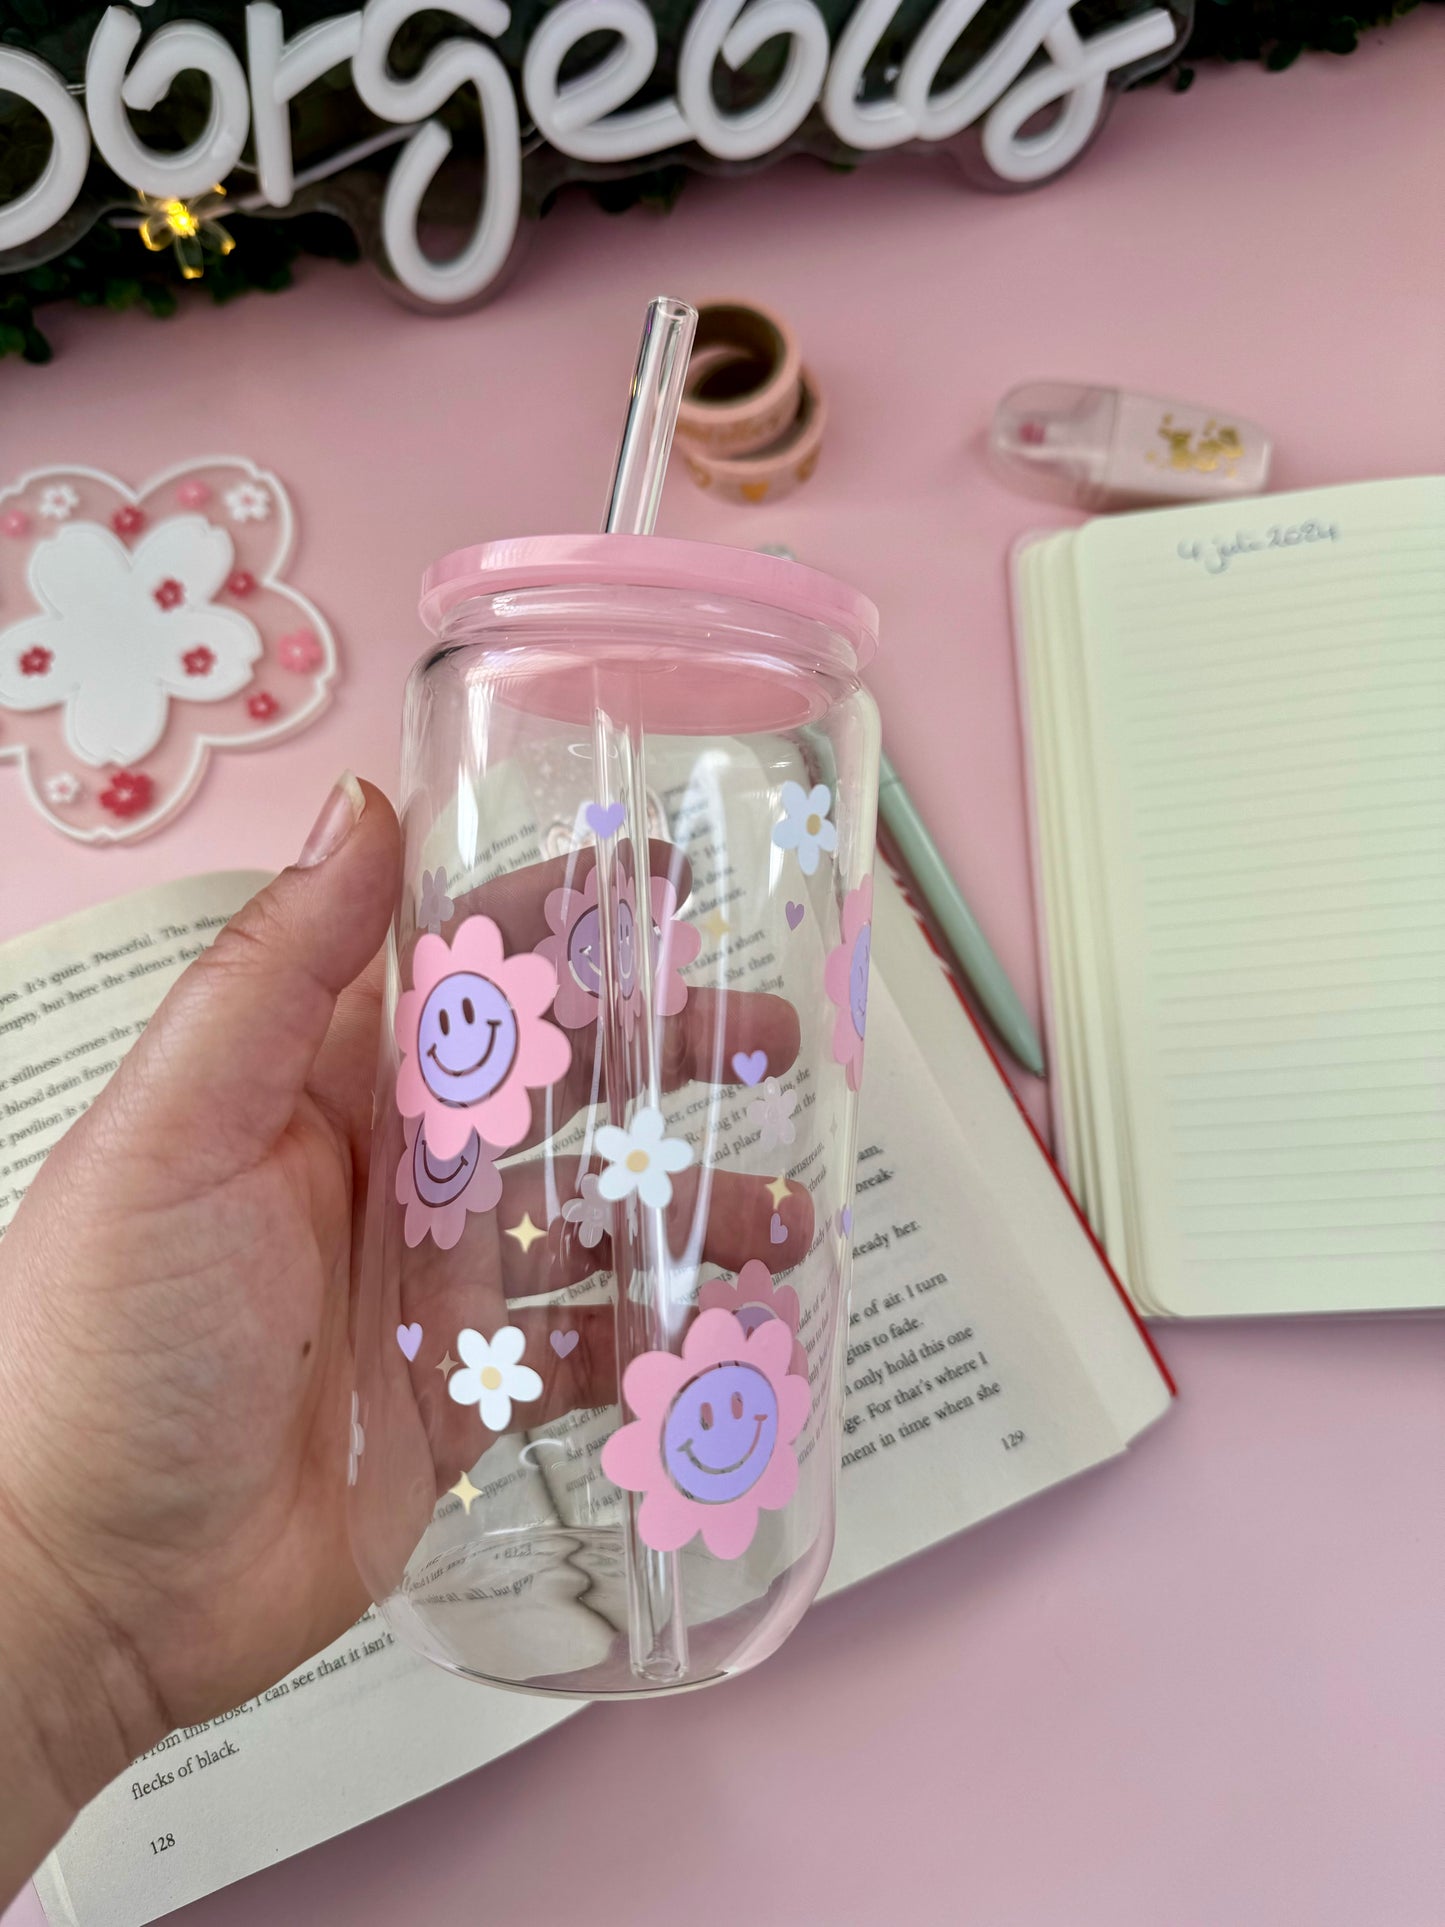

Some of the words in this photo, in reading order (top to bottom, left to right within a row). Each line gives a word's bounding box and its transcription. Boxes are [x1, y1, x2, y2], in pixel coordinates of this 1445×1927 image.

[1265, 517, 1340, 548] 2024
[92, 932, 158, 967] Peaceful.
[160, 923, 191, 940] The
[66, 983, 100, 1003] here
[101, 973, 127, 989] the
[128, 954, 177, 980] silence
[9, 1054, 63, 1088] stillness
[62, 1034, 109, 1062] comes
[108, 1023, 134, 1042] the
[3, 1086, 46, 1116] blood
[45, 1073, 83, 1099] drain
[82, 1058, 120, 1081] from
[8, 1111, 67, 1148] pavilion
[892, 1220, 922, 1239] her.
[863, 1298, 880, 1319] of
[882, 1293, 905, 1310] air.
[905, 1284, 915, 1299] I
[915, 1272, 948, 1293] turn
[872, 1332, 890, 1347] to
[889, 1317, 925, 1340] fade.
[853, 1367, 883, 1391] only
[883, 1348, 919, 1376] hold
[919, 1340, 946, 1359] this
[946, 1326, 974, 1346] one
[866, 1398, 893, 1419] For
[894, 1378, 934, 1405] that's
[935, 1358, 977, 1385] where
[878, 1432, 897, 1448] in
[898, 1415, 932, 1438] time
[934, 1400, 975, 1420] when
[976, 1381, 1001, 1401] she
[1001, 1430, 1025, 1451] 129
[264, 1683, 291, 1702] can
[292, 1670, 316, 1690] see
[317, 1655, 347, 1677] that
[349, 1646, 361, 1663] it
[362, 1631, 396, 1656] isn't
[131, 1772, 176, 1800] flecks
[177, 1756, 194, 1779] of
[195, 1739, 240, 1769] black.
[150, 1832, 176, 1855] 128
